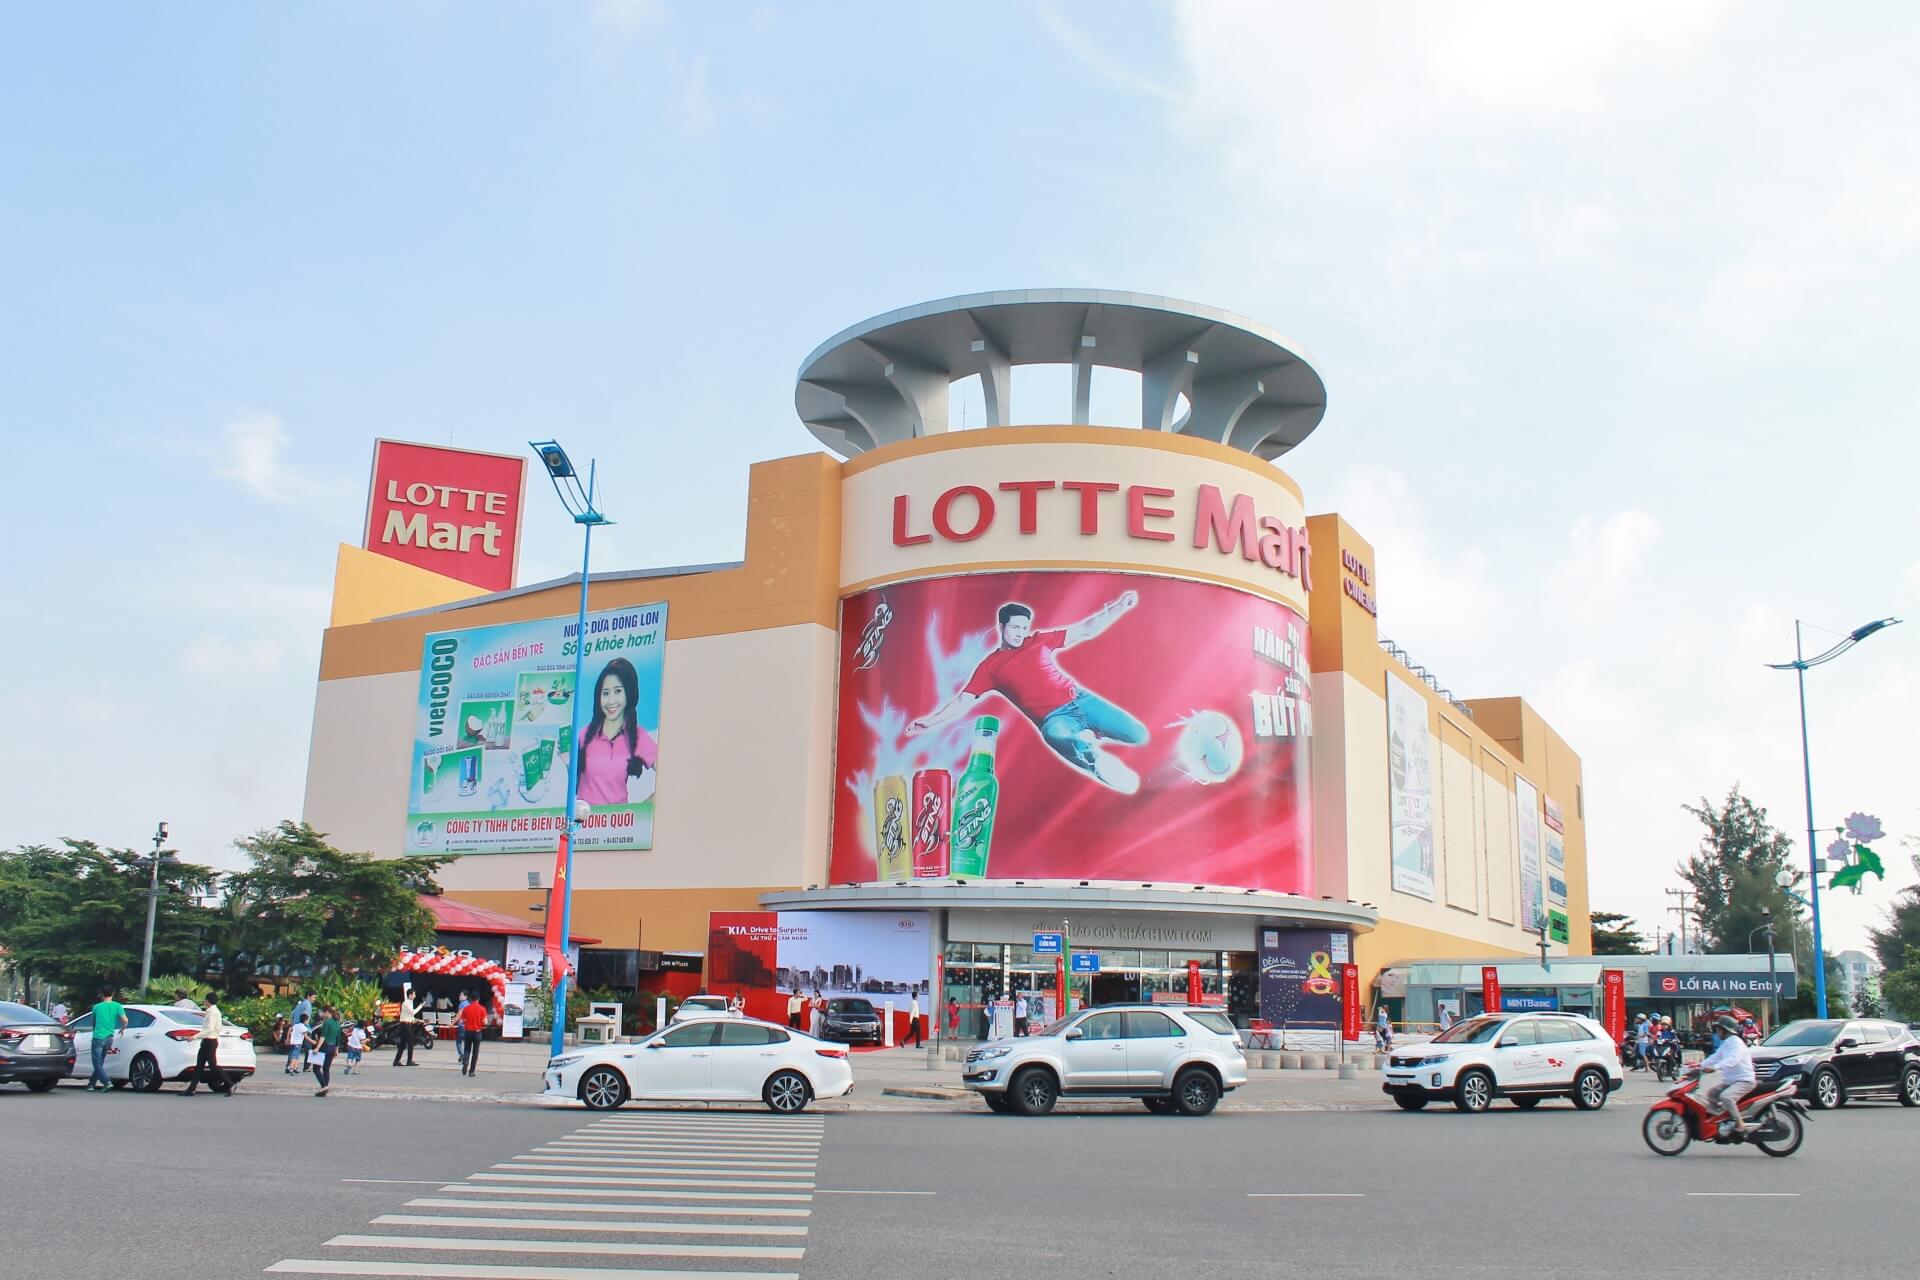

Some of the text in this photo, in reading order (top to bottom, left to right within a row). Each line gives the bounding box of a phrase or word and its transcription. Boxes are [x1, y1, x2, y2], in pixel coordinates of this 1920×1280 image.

[386, 479, 508, 515] LOTTE
[381, 509, 503, 557] Mart
[892, 479, 1313, 592] LOTTE Mart
[640, 610, 660, 627] LON
[530, 642, 544, 656] TRE
[446, 818, 469, 834] CÔNG
[473, 820, 484, 833] TY
[485, 819, 508, 833] TNHH
[959, 803, 992, 841] STING
[728, 926, 747, 935] KIA
[778, 926, 808, 934] Surprise
[1679, 975, 1699, 990] LỐI
[1702, 980, 1720, 990] RA
[1730, 980, 1747, 990] No
